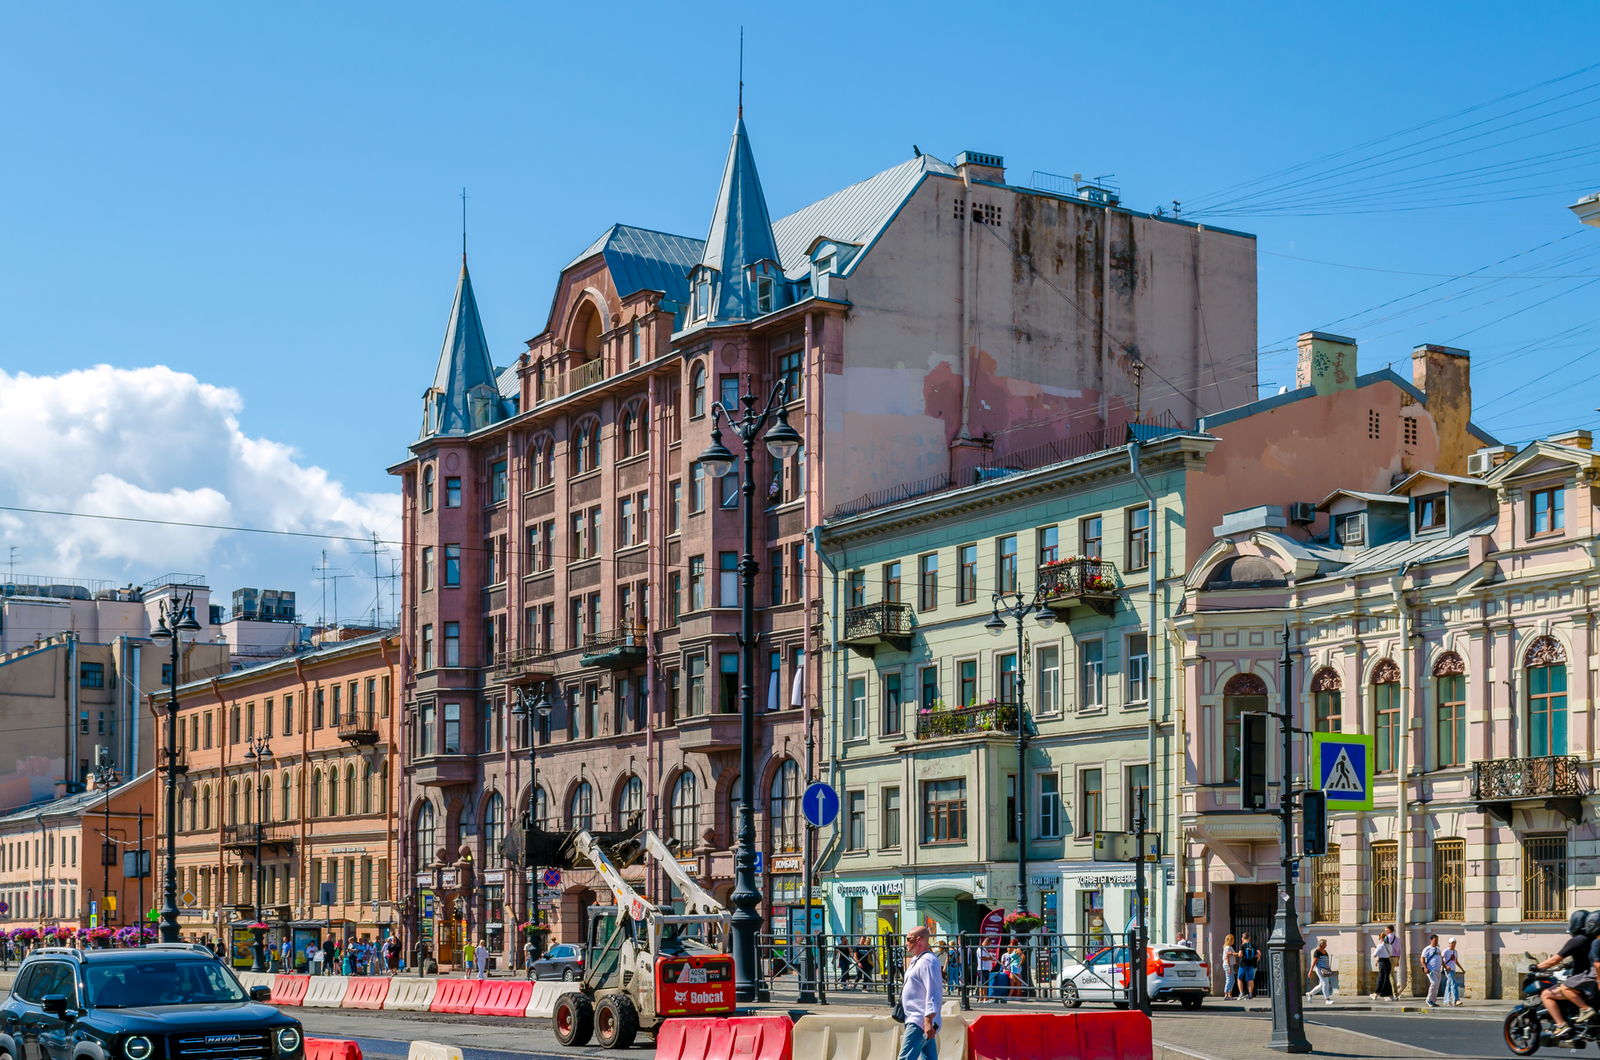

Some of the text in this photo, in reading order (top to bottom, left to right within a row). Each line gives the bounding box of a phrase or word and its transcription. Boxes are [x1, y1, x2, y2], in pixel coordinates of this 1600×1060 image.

[775, 860, 799, 869] ЛОМБАРД
[1077, 875, 1107, 884] КОНФЕТЫ
[690, 991, 724, 1004] Bobcat
